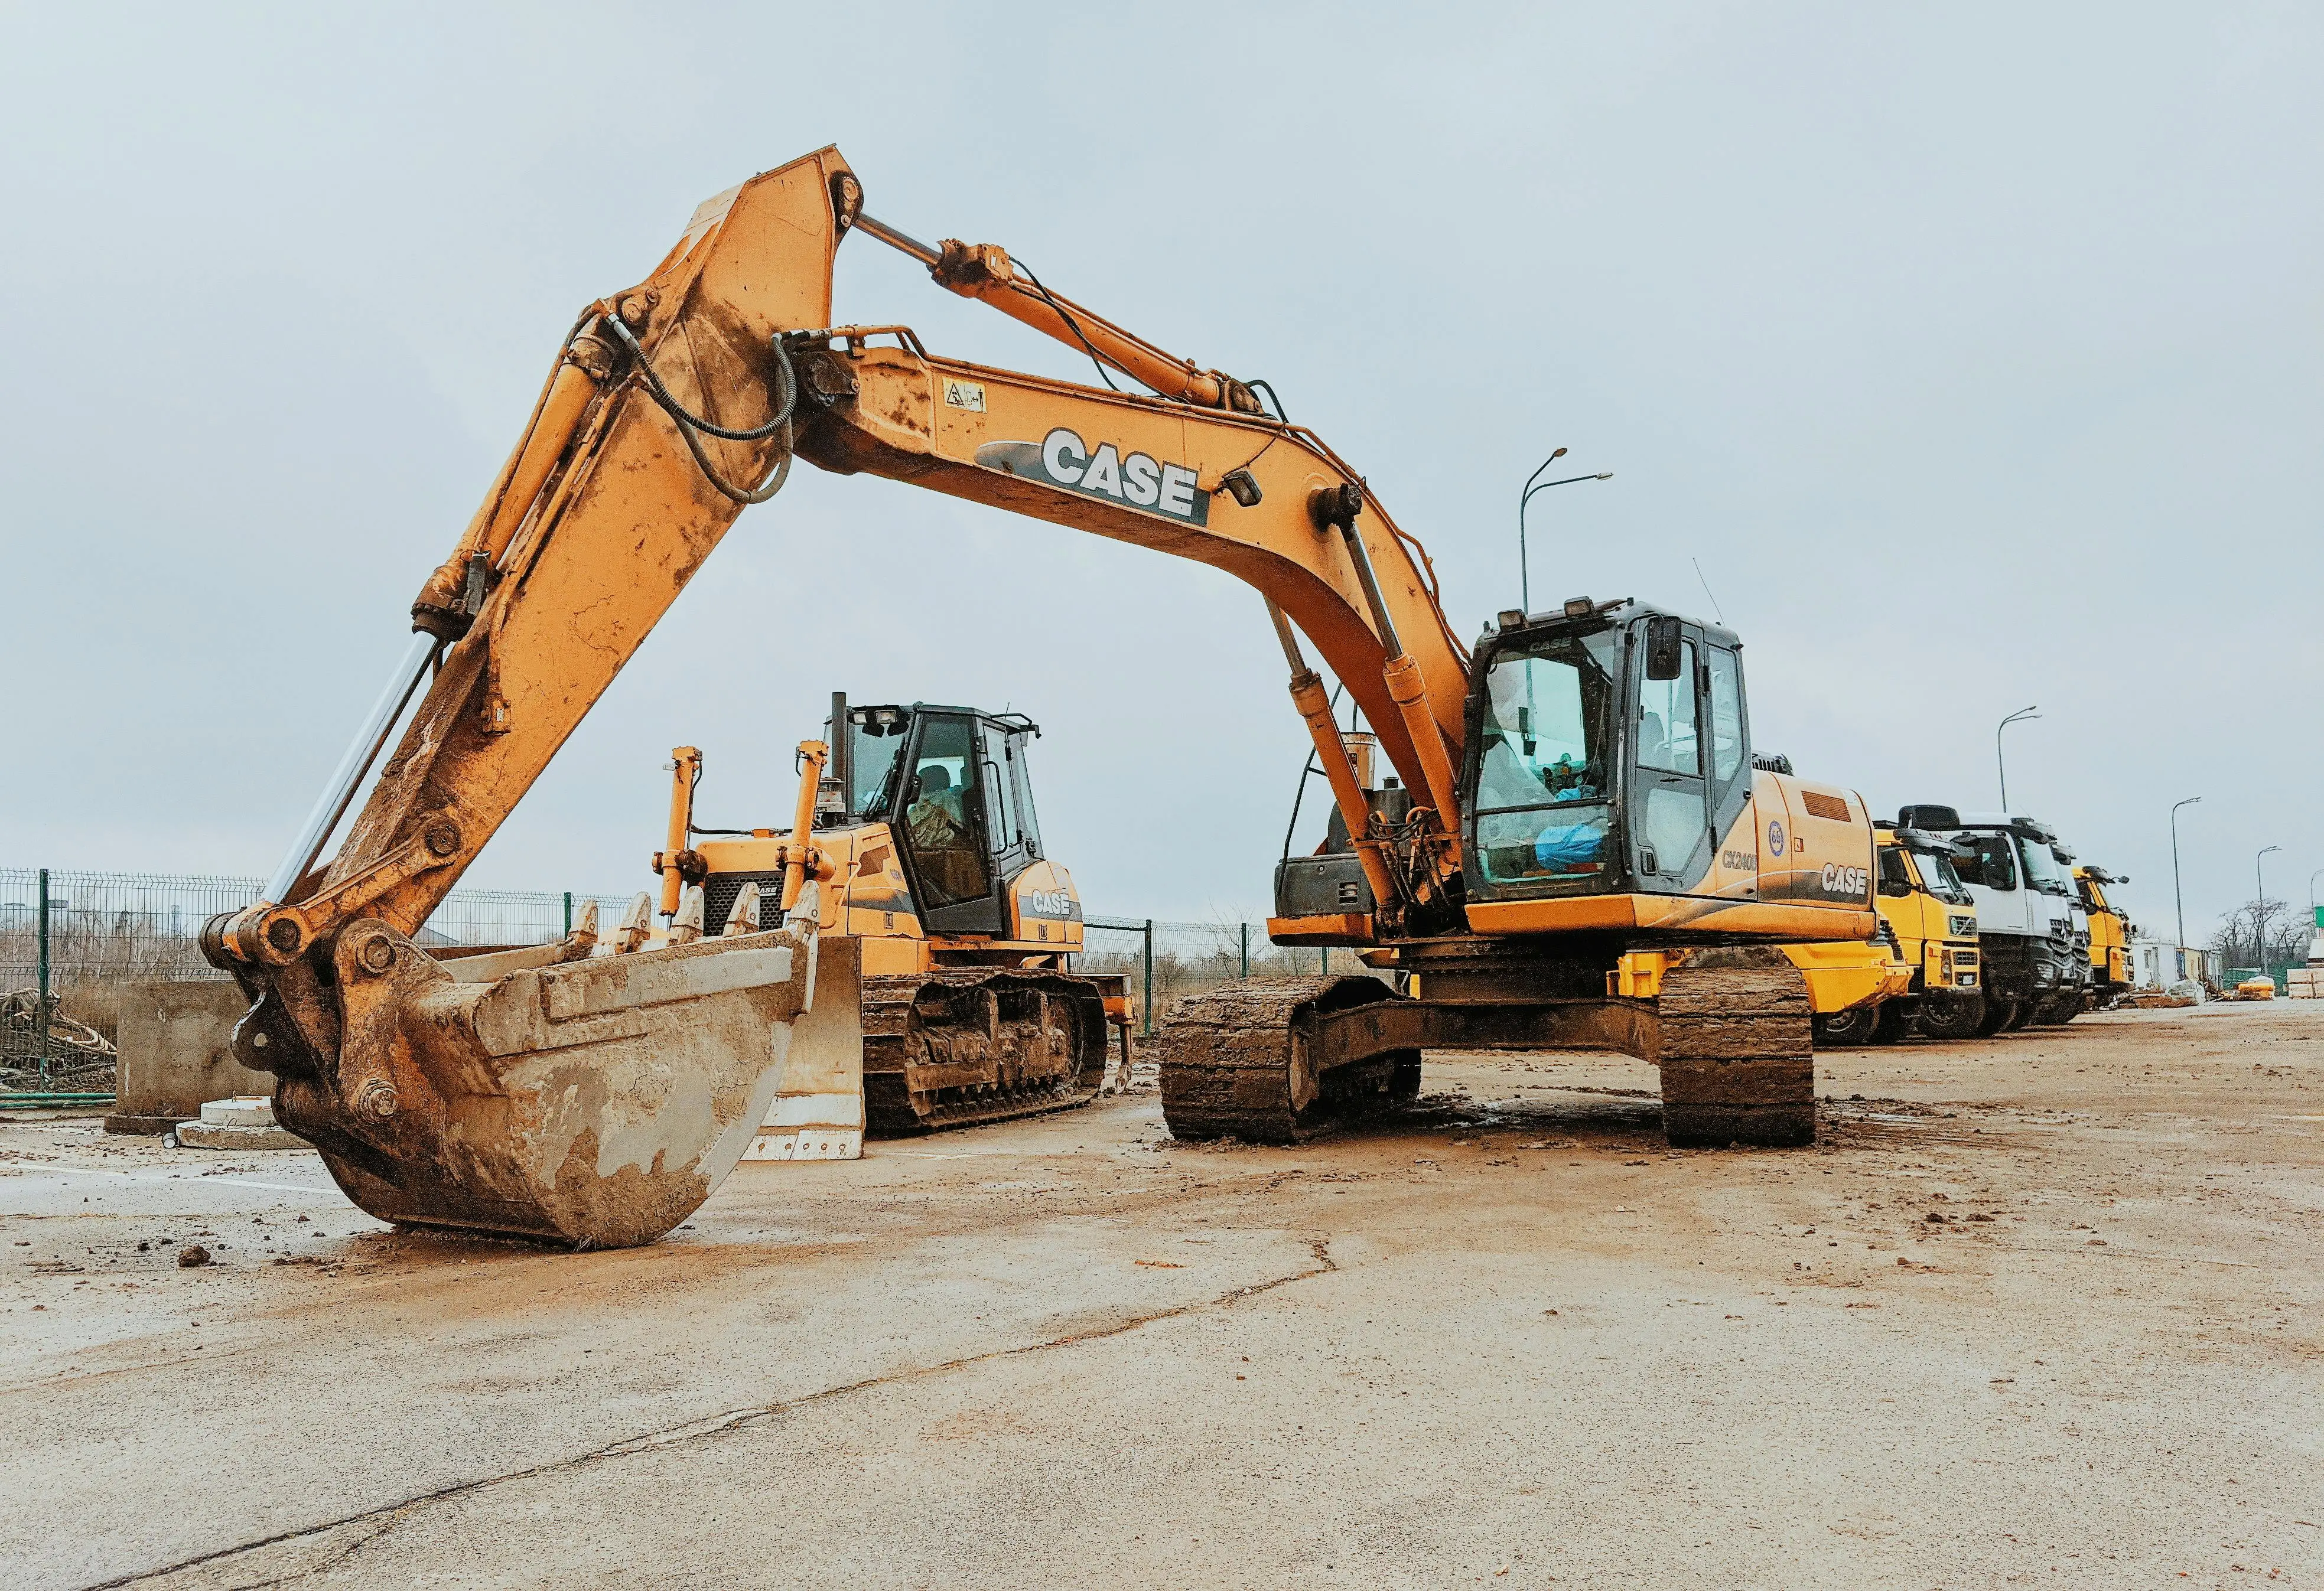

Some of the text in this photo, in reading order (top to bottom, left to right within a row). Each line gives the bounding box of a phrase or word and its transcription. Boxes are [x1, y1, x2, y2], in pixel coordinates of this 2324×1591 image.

[1041, 428, 1199, 517] CASE
[1529, 637, 1572, 652] CASE
[1821, 863, 1867, 895] CASE
[1032, 889, 1070, 915] CASE
